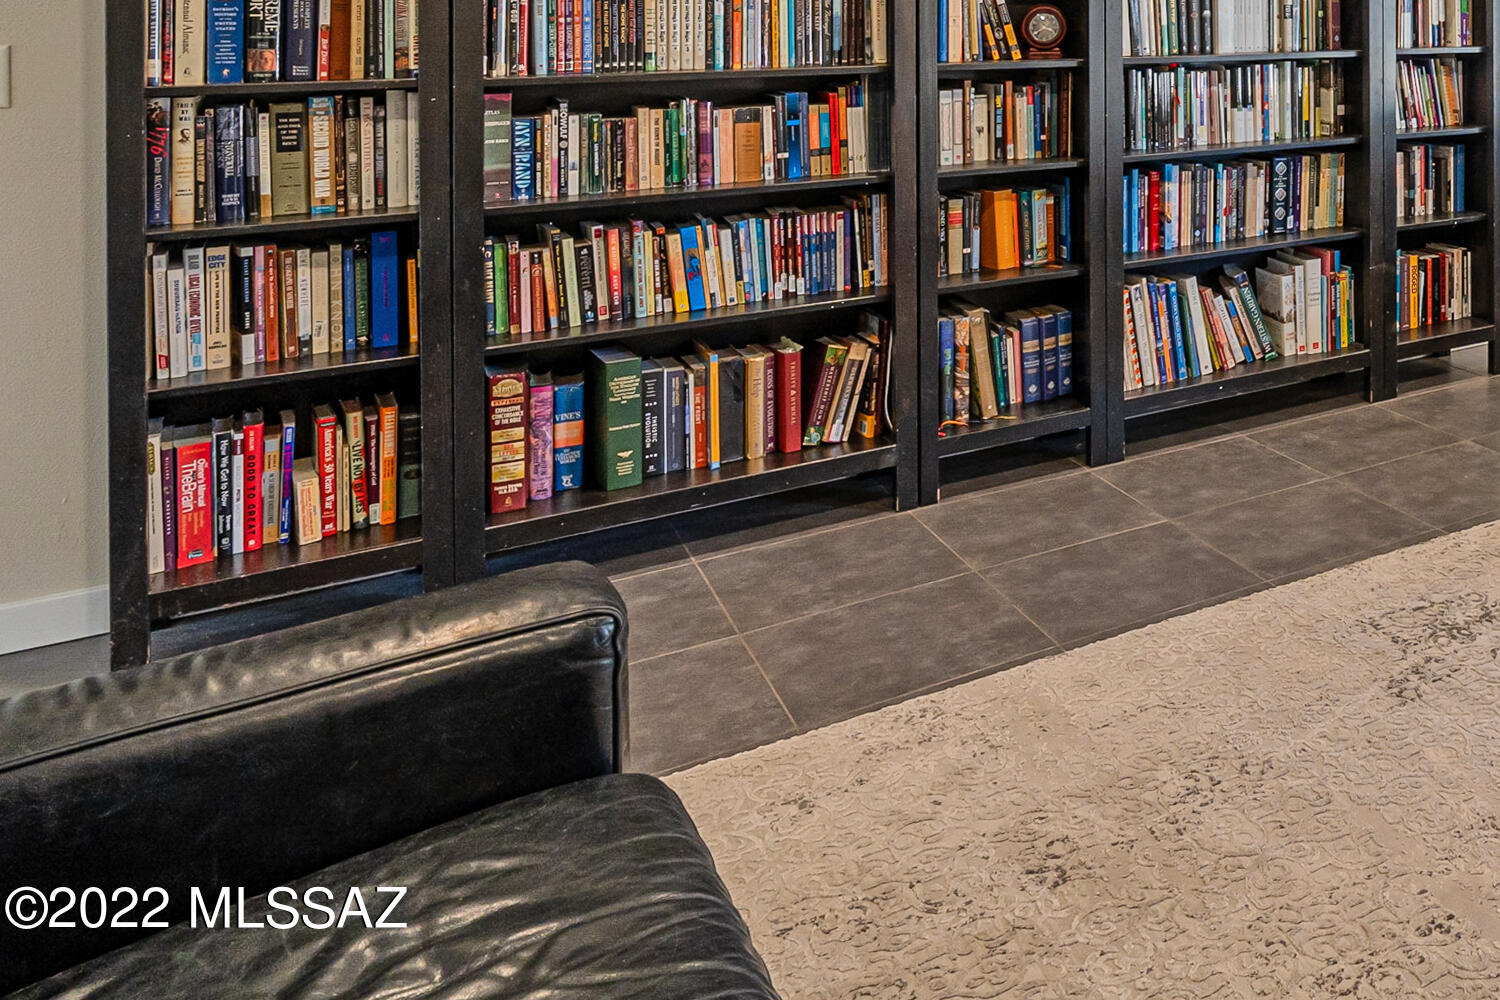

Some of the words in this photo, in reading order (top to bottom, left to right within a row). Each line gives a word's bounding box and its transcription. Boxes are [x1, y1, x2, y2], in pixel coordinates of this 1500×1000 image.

[510, 10, 519, 23] GOD
[183, 24, 194, 54] Almanac
[313, 116, 330, 147] SECOND
[515, 121, 531, 147] AYN
[146, 127, 170, 158] 1776
[314, 149, 330, 178] WORLD
[514, 154, 531, 188] RAND
[315, 179, 330, 198] WAR
[189, 274, 201, 289] LOCAL
[173, 280, 181, 312] SUBURBAN
[189, 290, 201, 318] ECONOMIC
[1243, 286, 1261, 320] GARDEN
[330, 300, 343, 345] KNOX
[1252, 320, 1273, 355] WESTERN
[767, 390, 774, 398] OF
[555, 411, 581, 422] VINE'S
[815, 404, 825, 426] DOWN
[220, 440, 229, 456] How
[324, 428, 334, 462] America's
[352, 445, 362, 462] LIVE
[197, 458, 206, 484] Owner's
[220, 456, 229, 468] We
[247, 455, 256, 482] GOOD
[324, 463, 335, 473] 30
[219, 468, 229, 482] Got
[353, 464, 363, 480] NOT
[220, 482, 228, 490] to
[247, 487, 256, 499] TO
[324, 474, 334, 493] Years
[355, 483, 363, 493] BY
[219, 491, 229, 507] Now
[325, 495, 335, 509] War
[355, 496, 365, 514] LIES
[247, 504, 256, 535] GREAT
